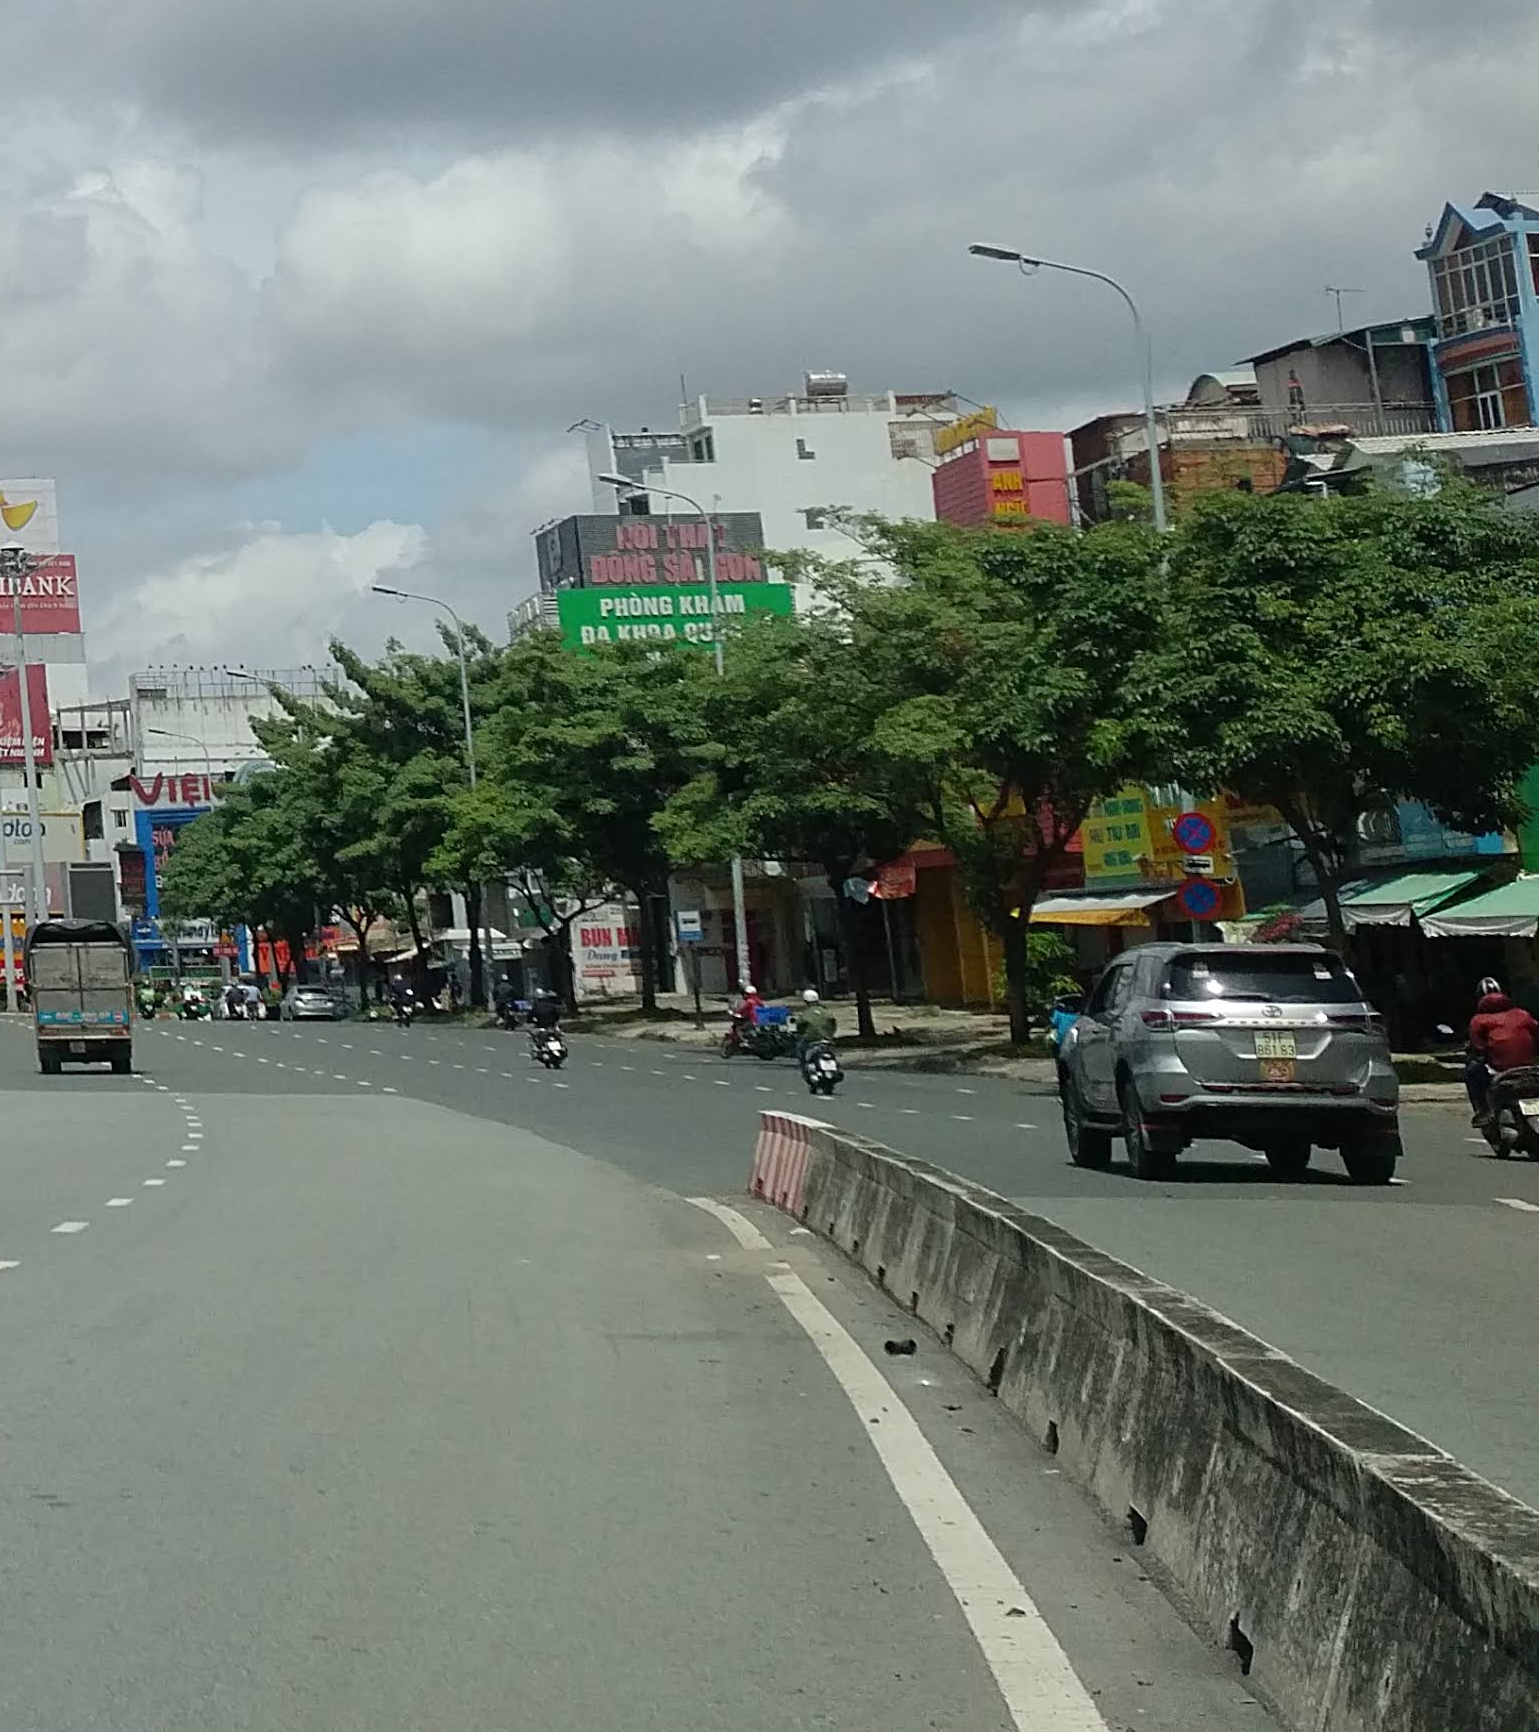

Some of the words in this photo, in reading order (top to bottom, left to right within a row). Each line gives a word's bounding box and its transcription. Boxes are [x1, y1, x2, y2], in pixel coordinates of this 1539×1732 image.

[600, 592, 673, 618] PHÒNG
[679, 589, 746, 615] KHÁM
[1264, 1033, 1285, 1043] 51F
